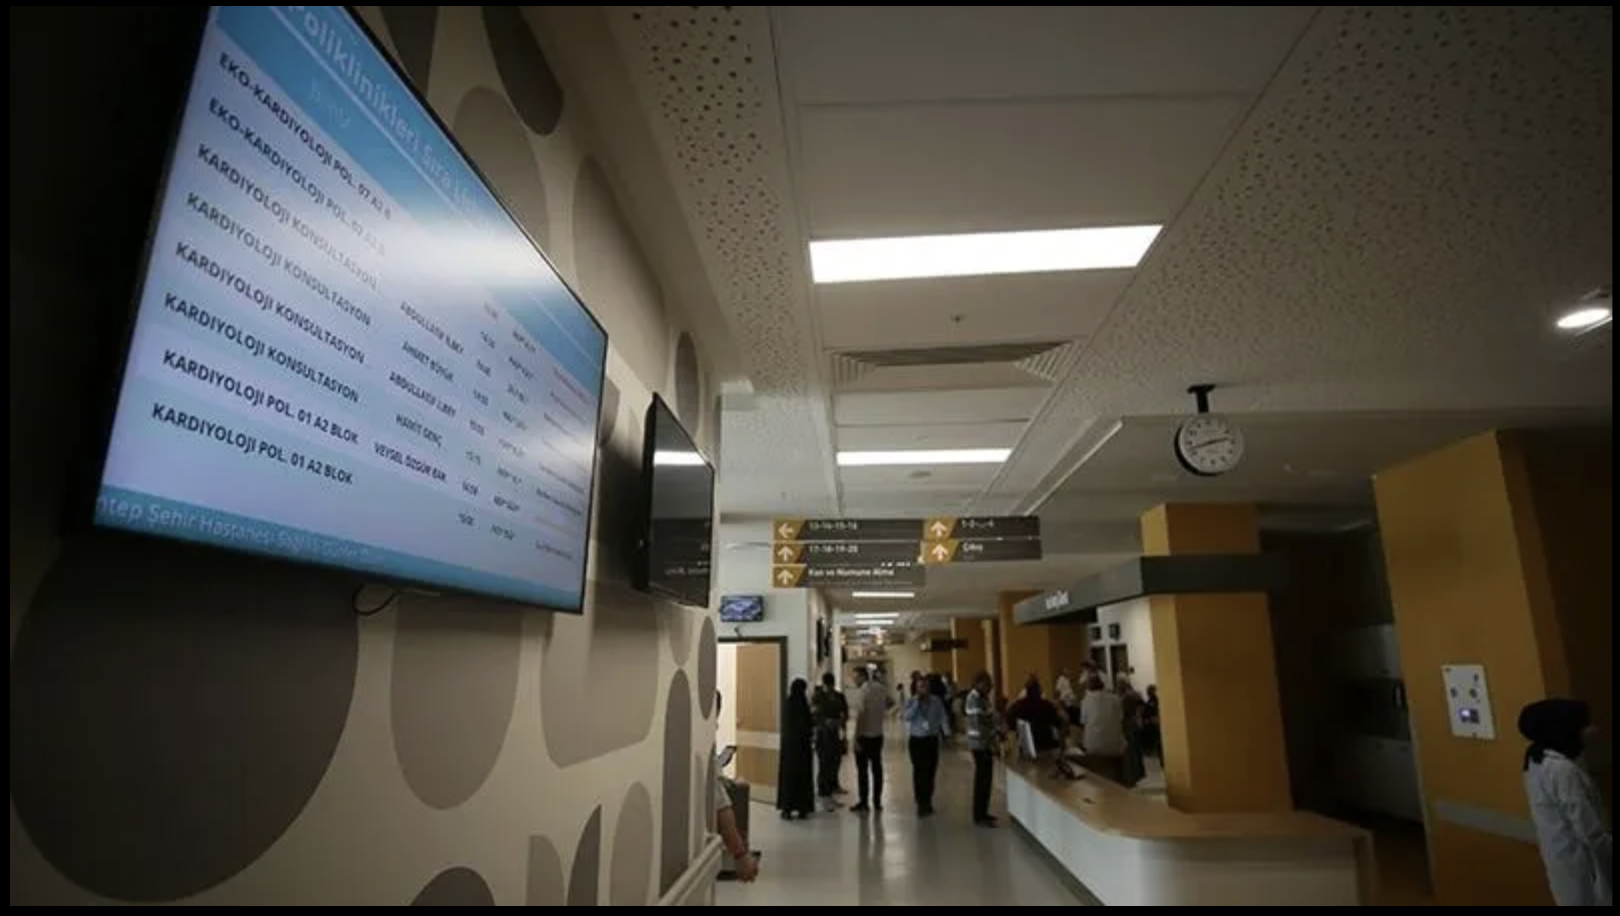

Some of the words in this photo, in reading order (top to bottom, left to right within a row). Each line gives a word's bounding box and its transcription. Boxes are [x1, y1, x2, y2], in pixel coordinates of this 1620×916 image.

[197, 143, 290, 225] KARDIYOLOJI
[175, 241, 272, 311] KARDIYOLOJI
[275, 302, 365, 364] KONSULTASYON
[186, 191, 281, 268] KARDIYOLOJI
[284, 259, 371, 326] KONSULTASYON
[163, 349, 265, 406] KARDIYOLOJI
[266, 395, 295, 420] POL.
[297, 408, 312, 425] 01
[313, 415, 329, 433] A2
[330, 421, 359, 445] BLOK
[164, 291, 265, 356] KARDIYOLOJI
[267, 346, 359, 402] KONSULTASYON
[152, 403, 256, 455] KARDIYOLOJI
[258, 440, 287, 463] POL.
[290, 451, 305, 468] 01
[307, 458, 323, 476] A2
[324, 463, 353, 485] BLOK
